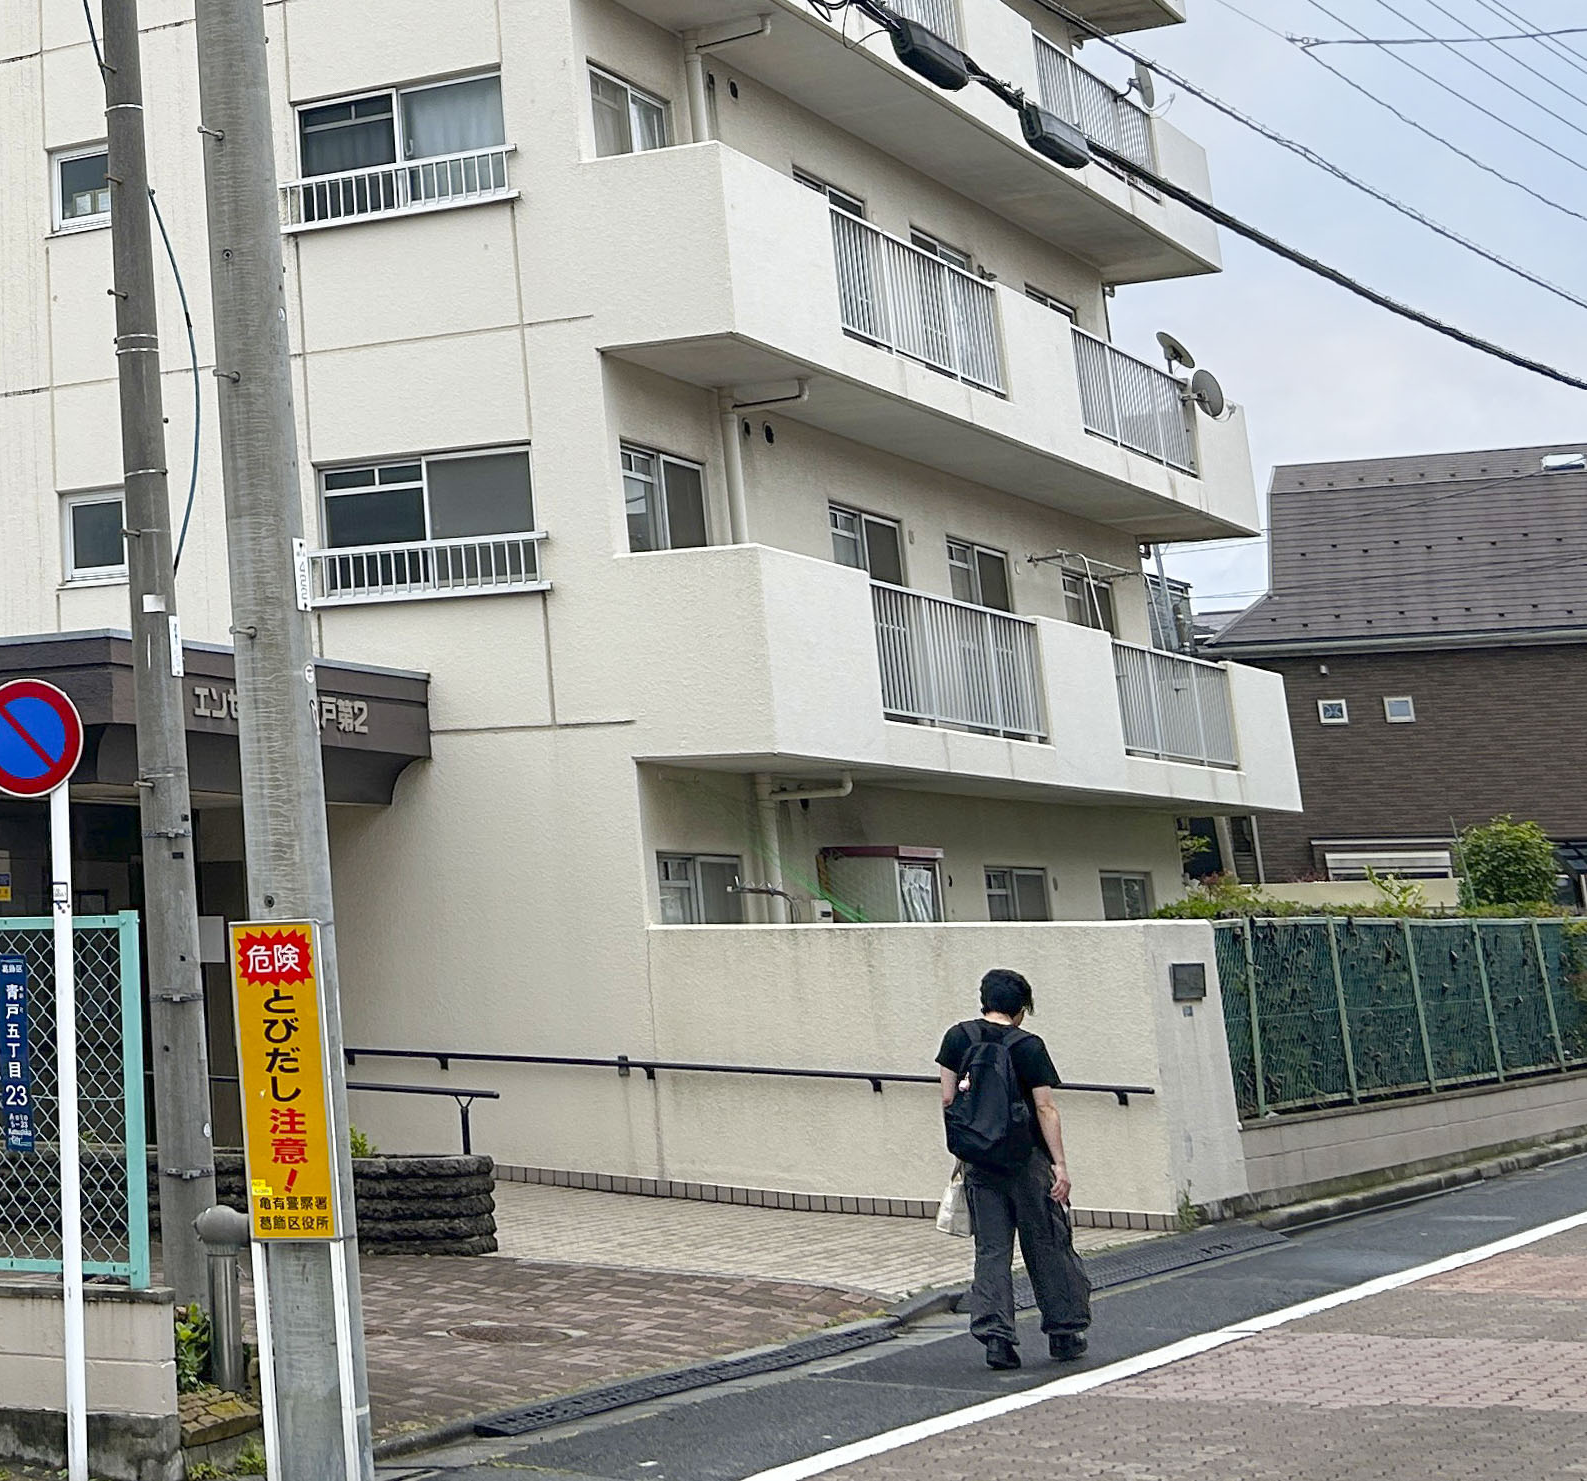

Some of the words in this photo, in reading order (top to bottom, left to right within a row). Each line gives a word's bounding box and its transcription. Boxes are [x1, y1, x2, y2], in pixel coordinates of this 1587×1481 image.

[246, 943, 301, 973] 危険
[5, 984, 21, 1079] 青戸五丁目
[5, 1084, 28, 1106] 23
[259, 1215, 328, 1230] 葛飾区役所
